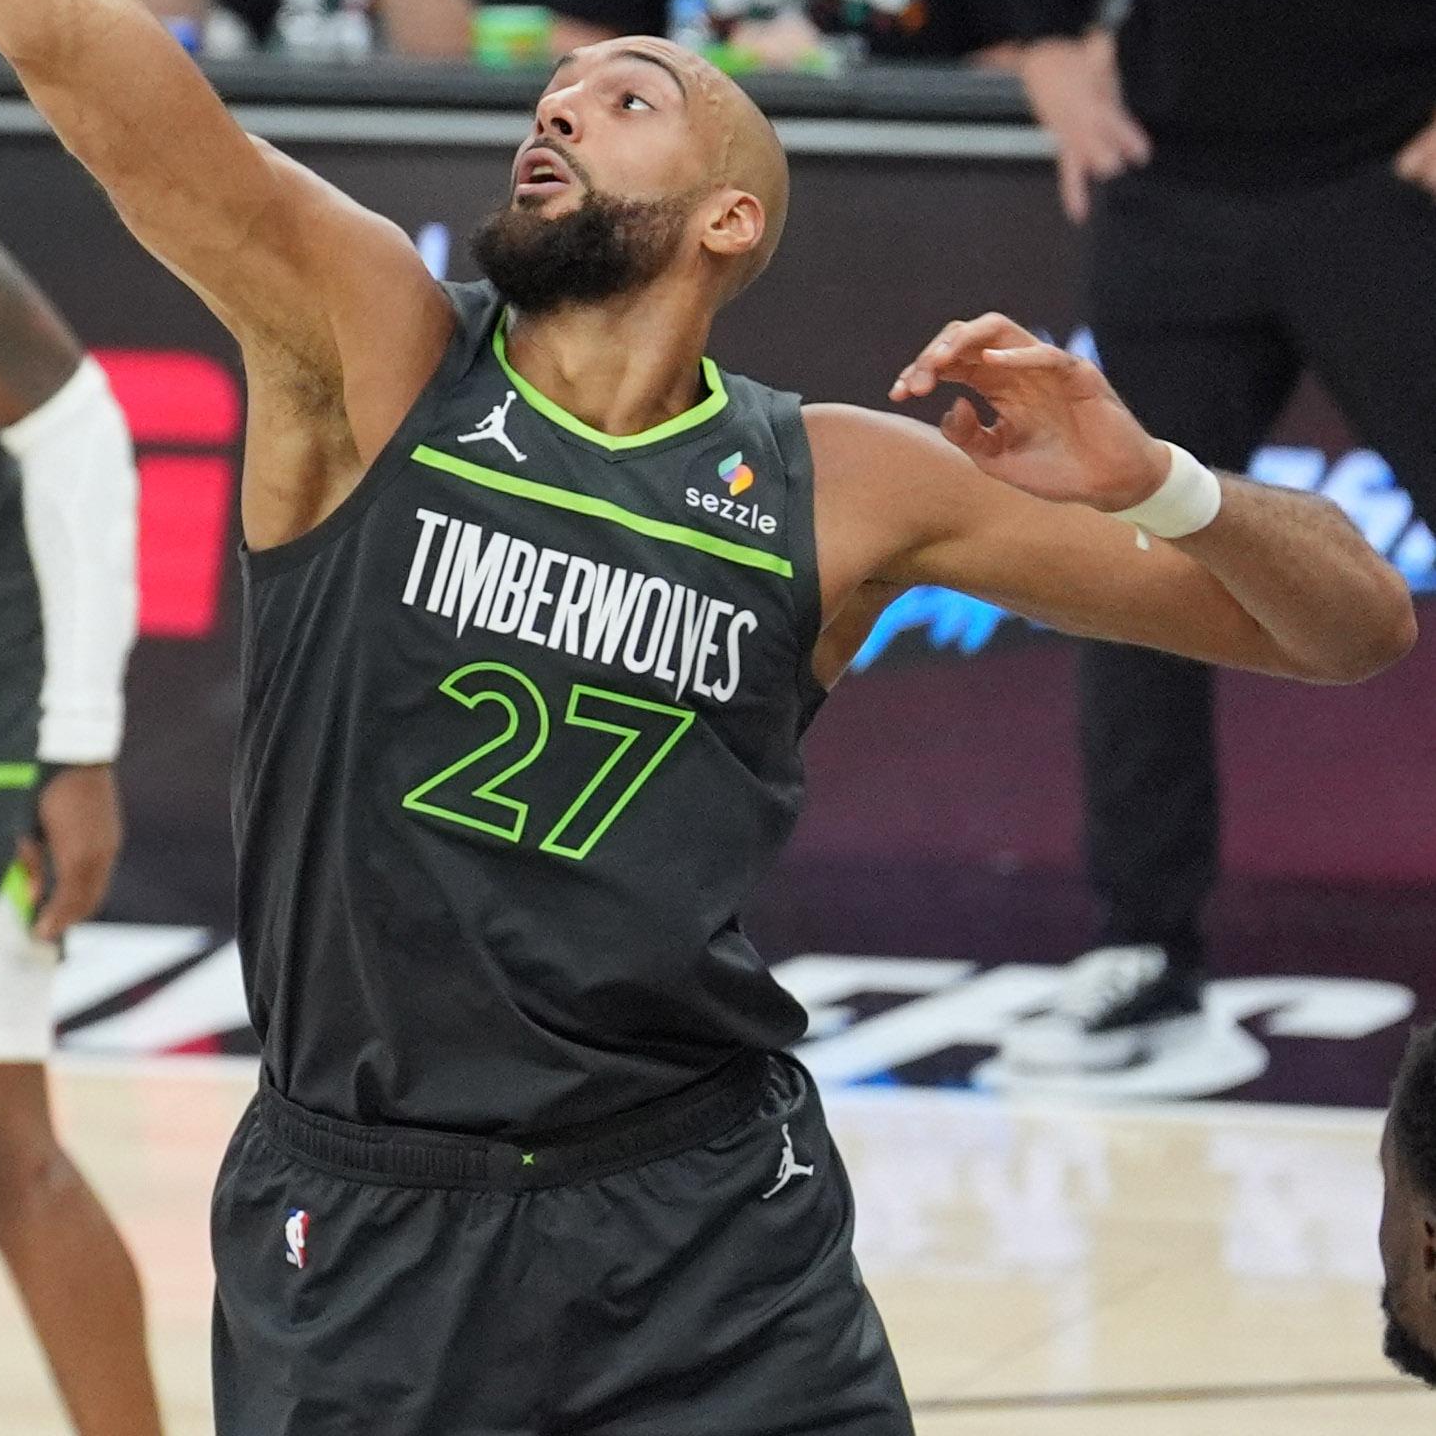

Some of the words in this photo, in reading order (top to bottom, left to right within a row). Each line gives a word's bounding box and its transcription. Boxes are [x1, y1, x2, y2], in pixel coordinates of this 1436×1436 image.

[401, 507, 759, 704] TIMBERWOLVES
[684, 486, 778, 536] sezzle
[401, 660, 697, 861] 27
